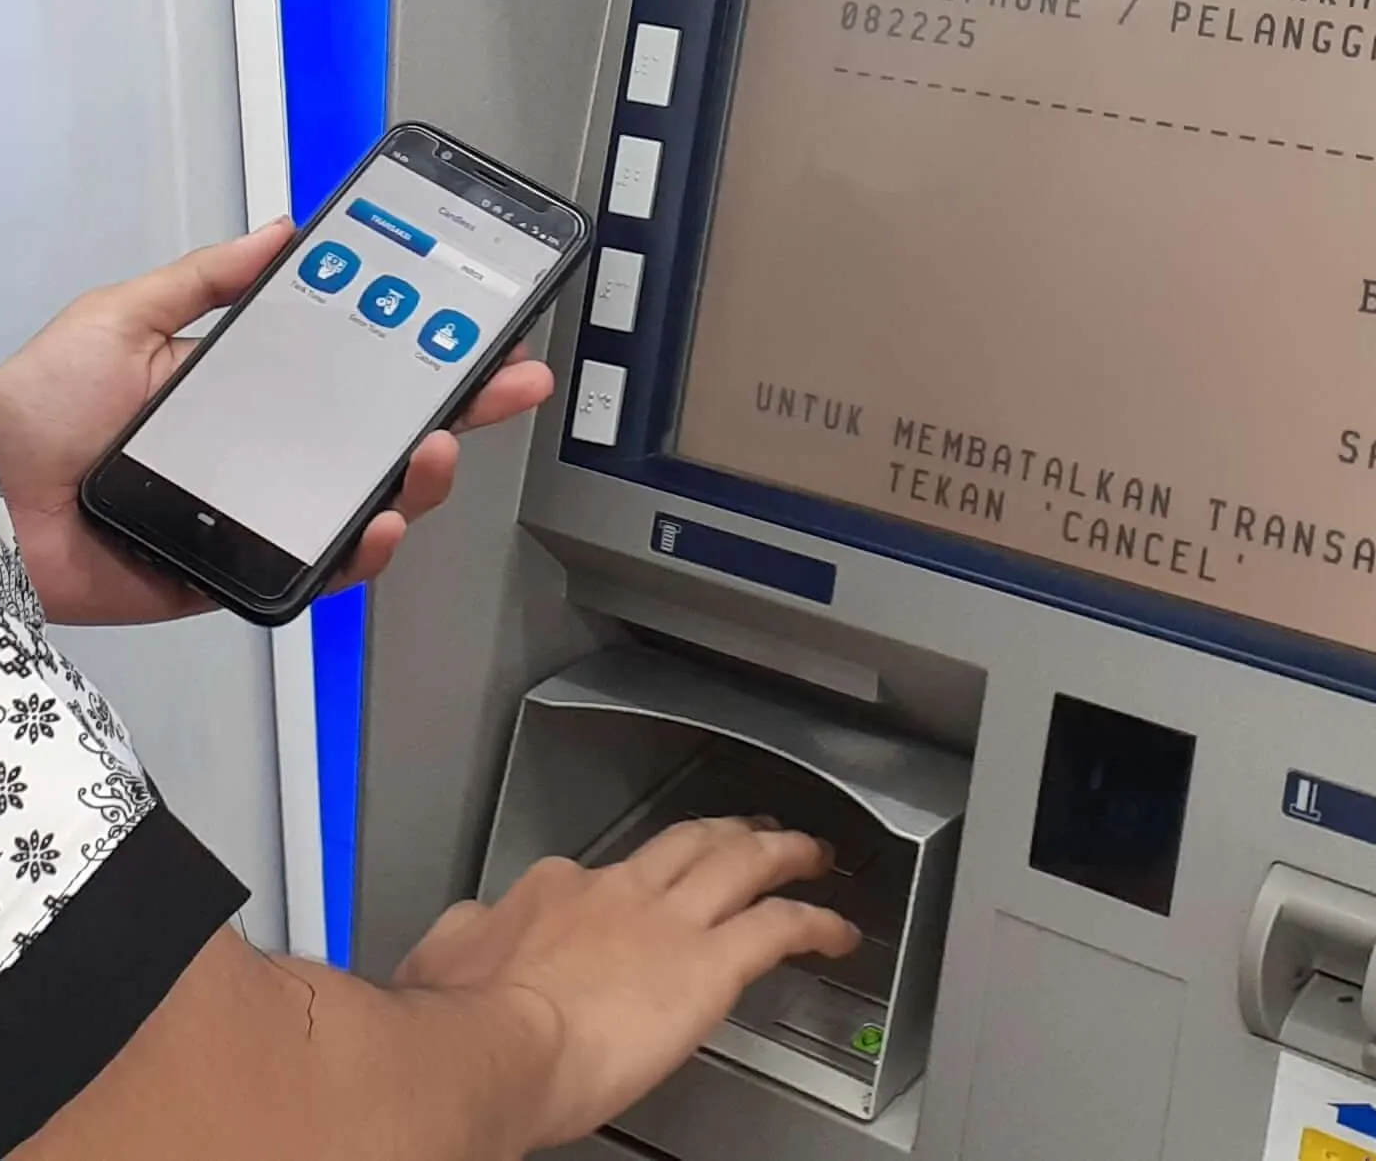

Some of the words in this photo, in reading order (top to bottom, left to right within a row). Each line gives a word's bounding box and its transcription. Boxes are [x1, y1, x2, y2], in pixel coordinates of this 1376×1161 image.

[840, 0, 978, 50] 082225
[756, 381, 864, 436] UNTUK
[893, 416, 1172, 519] MEMBATALKAN
[888, 461, 1006, 522] TEKAN
[1044, 501, 1245, 583] 'CANCEL'
